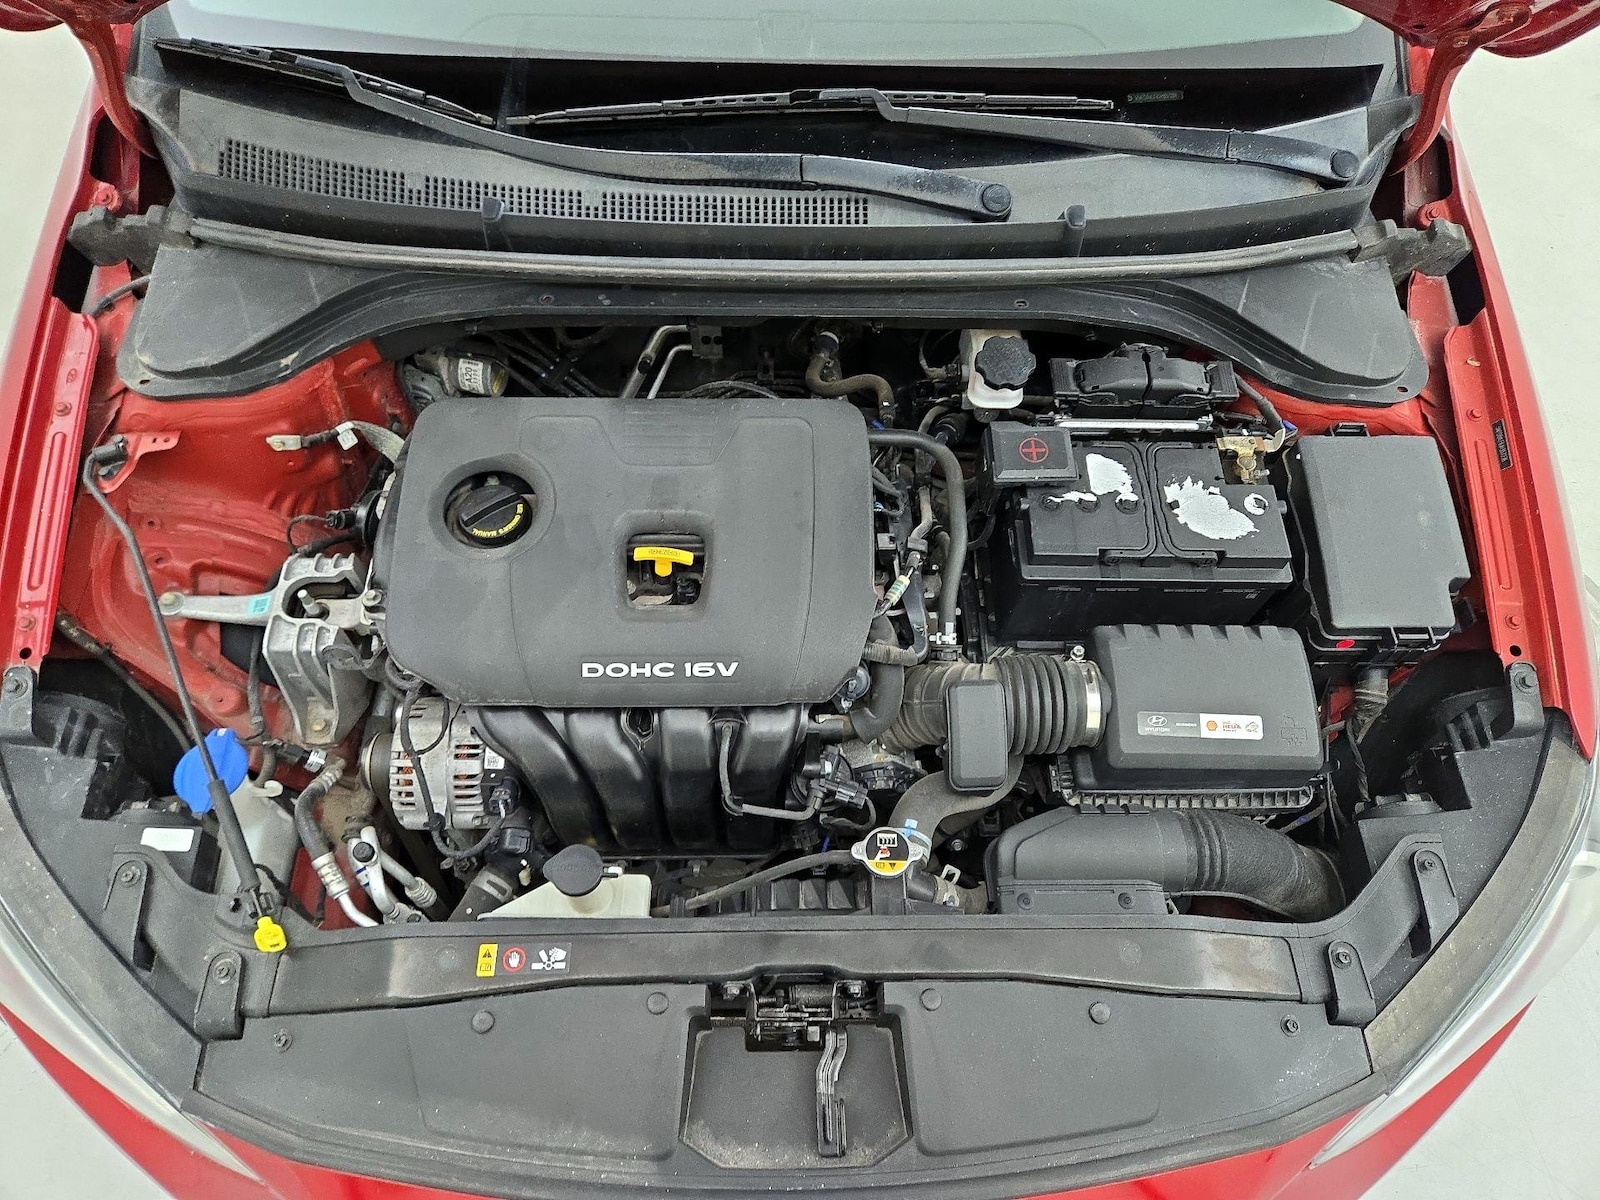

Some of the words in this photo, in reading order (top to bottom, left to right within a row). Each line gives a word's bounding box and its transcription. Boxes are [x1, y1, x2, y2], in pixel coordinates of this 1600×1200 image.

[472, 527, 498, 537] MANUAL
[581, 662, 675, 678] DOHC
[684, 661, 739, 677] 16V
